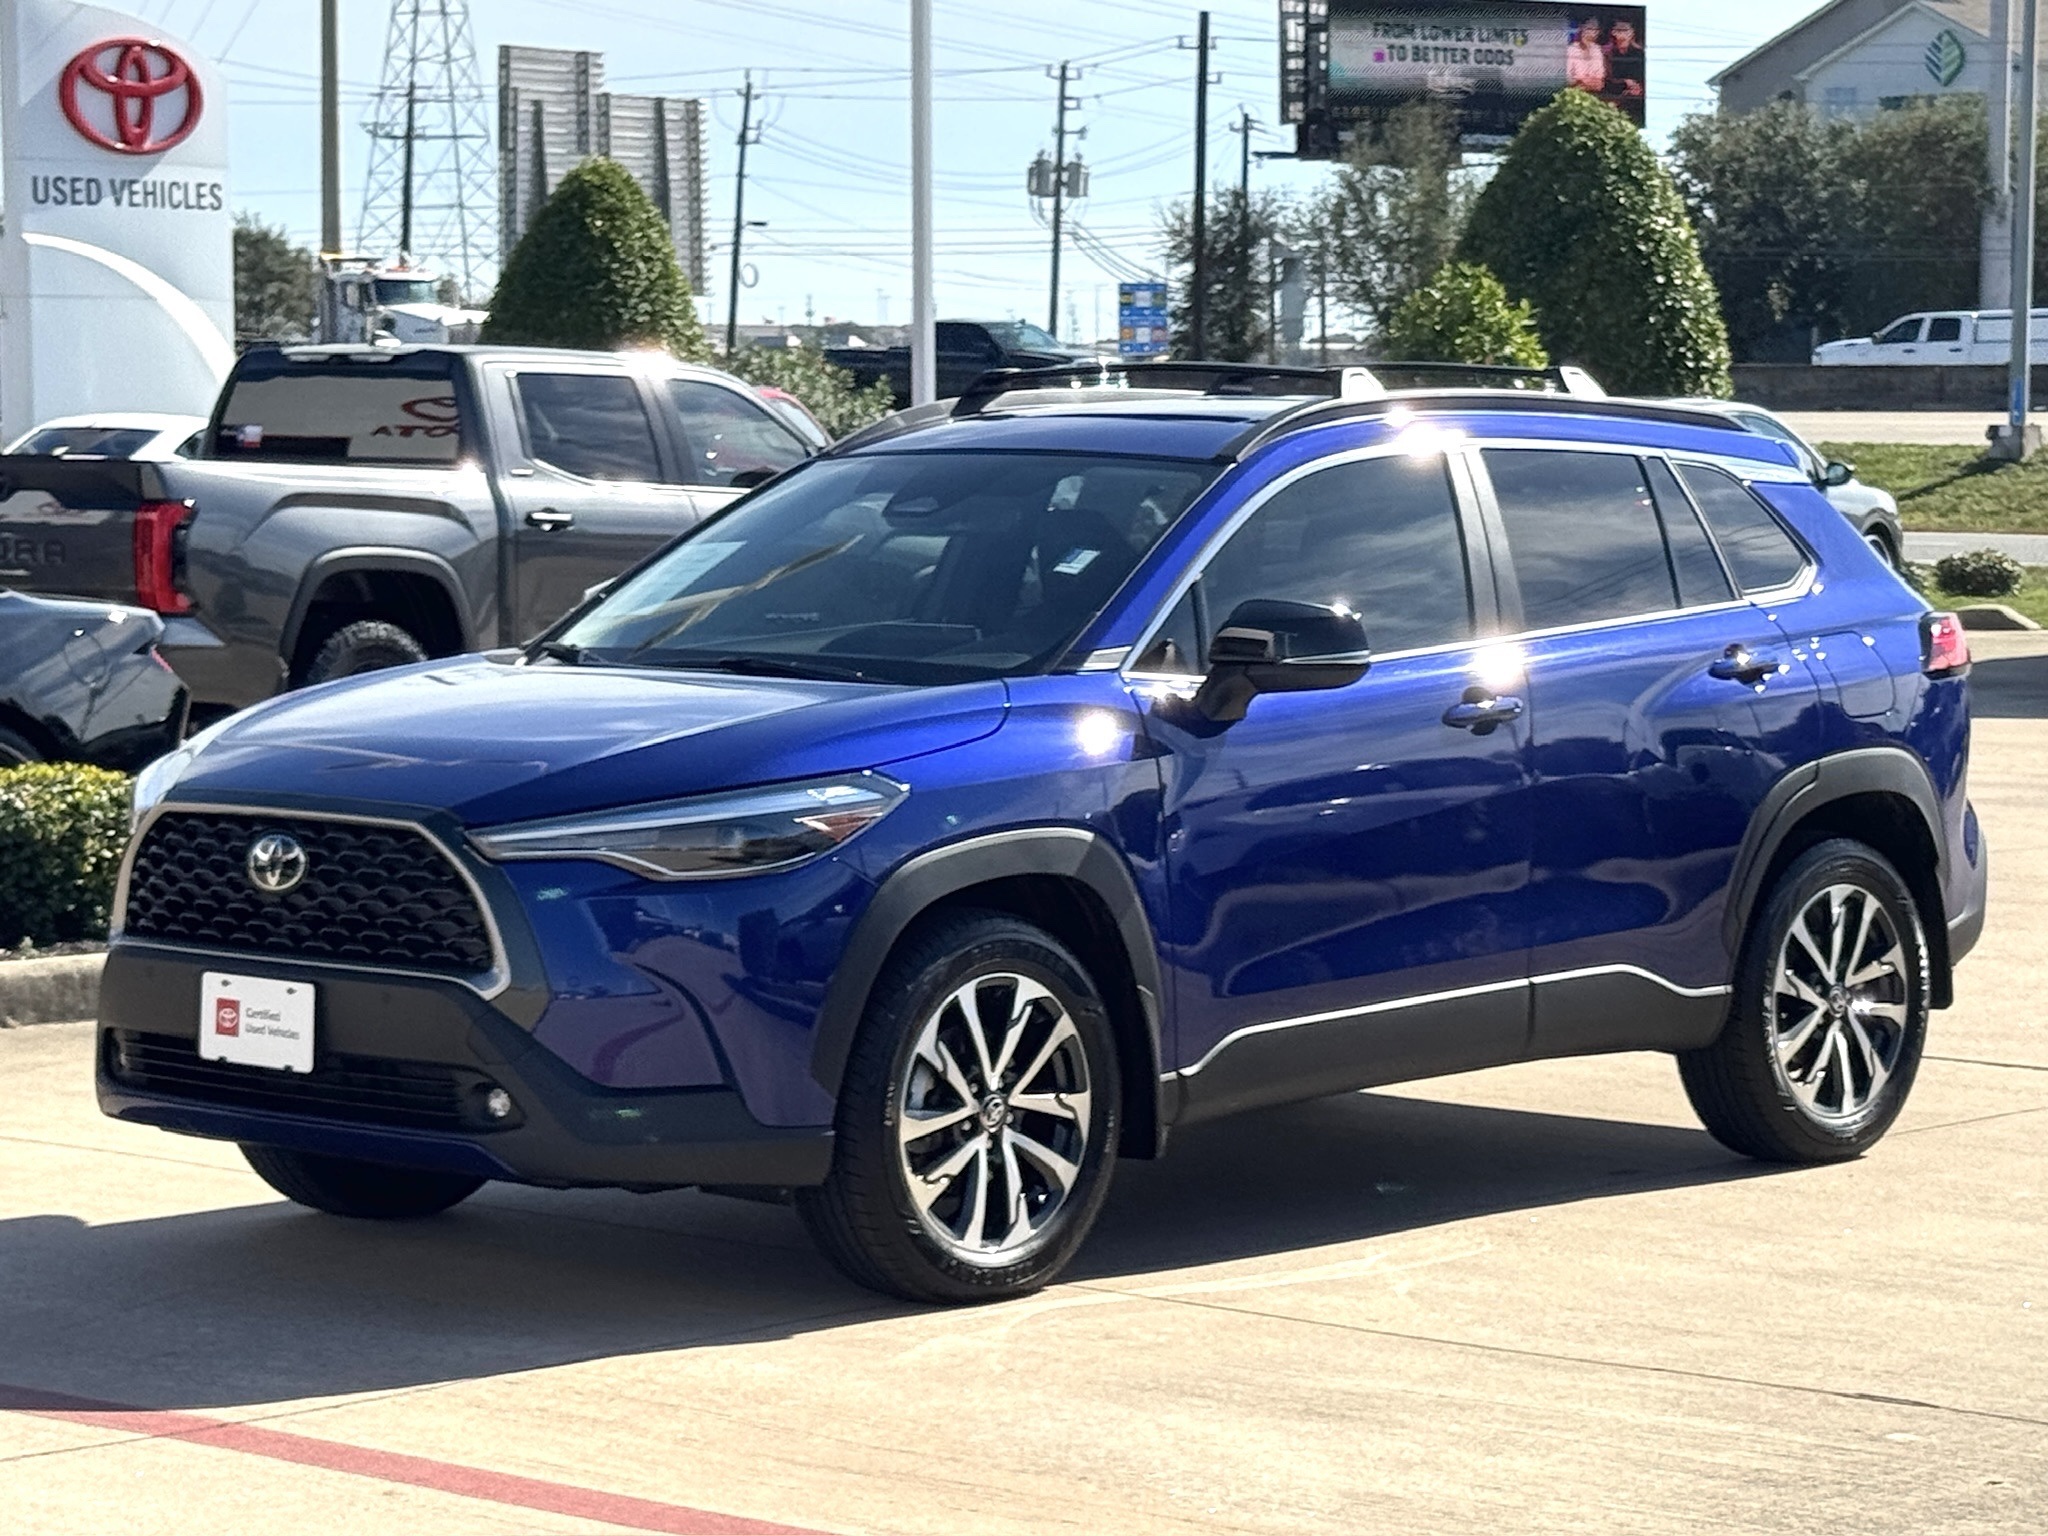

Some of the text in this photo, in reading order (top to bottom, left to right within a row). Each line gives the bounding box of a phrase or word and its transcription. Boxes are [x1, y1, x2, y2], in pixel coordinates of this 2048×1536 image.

[1372, 22, 1529, 46] FROM LOWER LIMITS
[1387, 44, 1408, 62] TO
[1411, 45, 1471, 64] BETTER
[31, 175, 222, 211] USED VEHICLES
[267, 1025, 300, 1040] Vehicles
